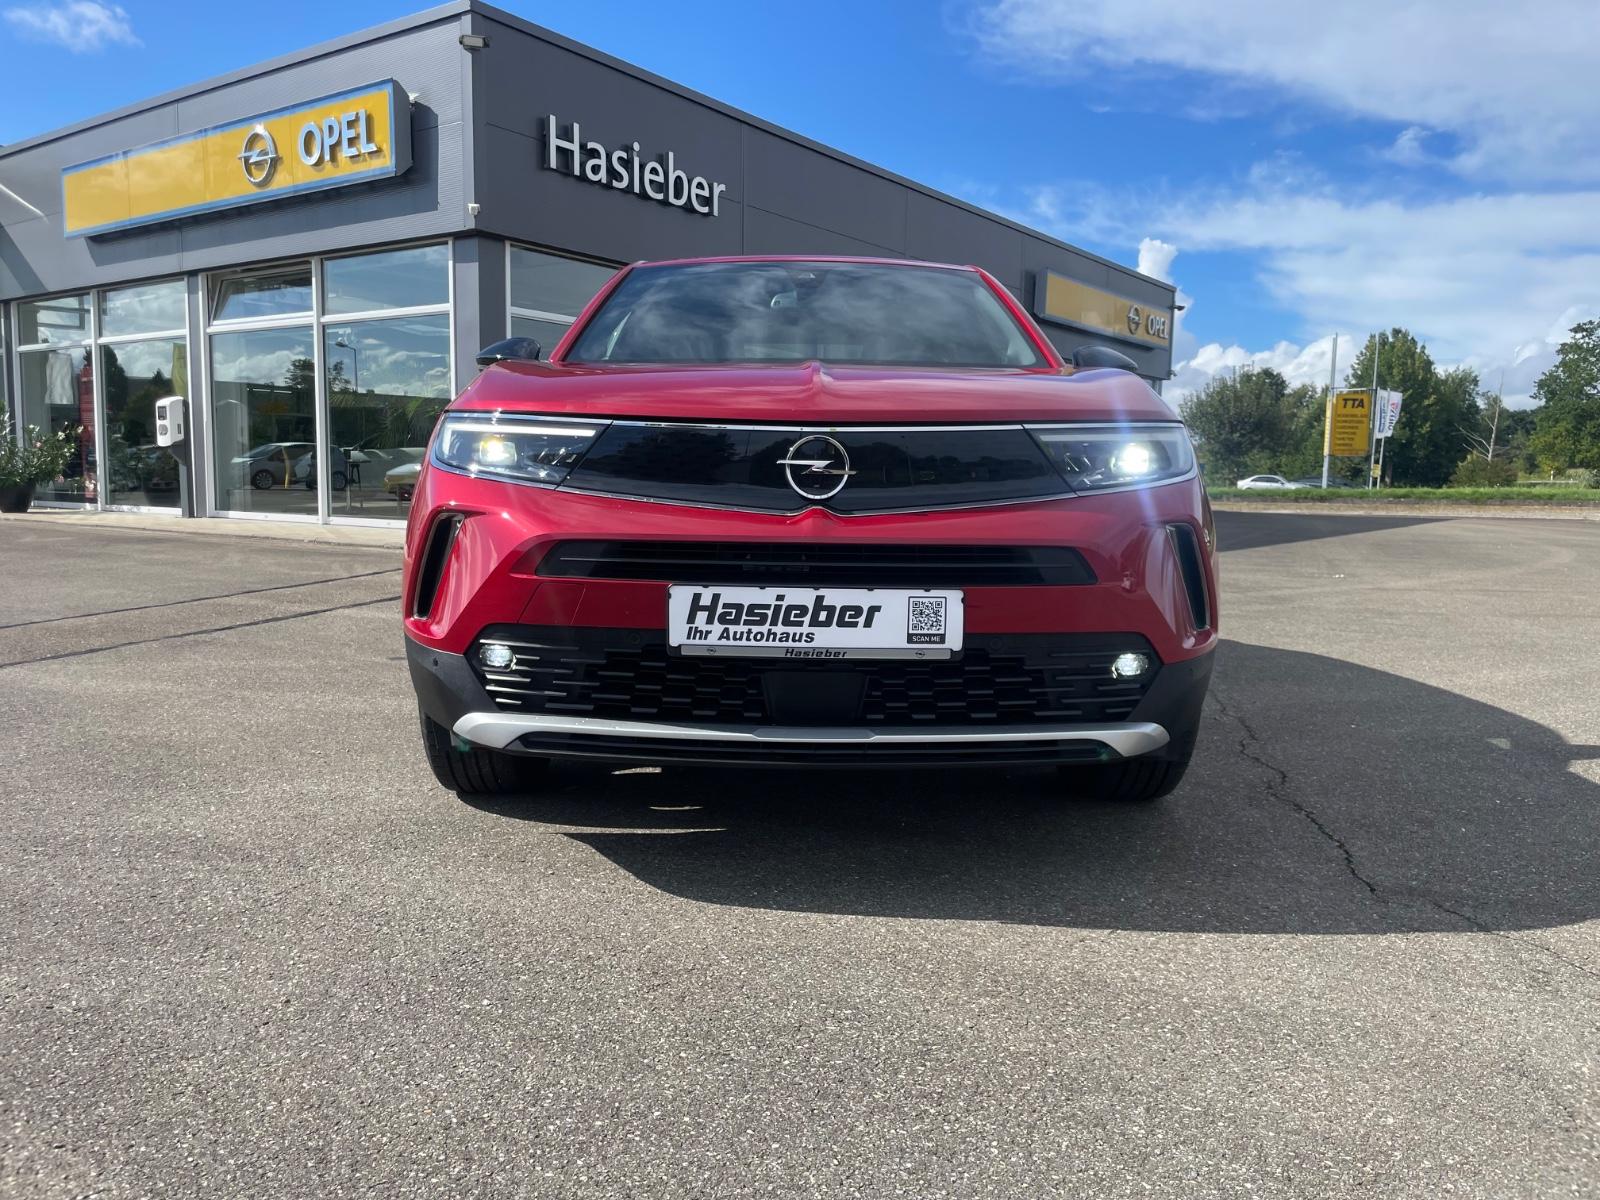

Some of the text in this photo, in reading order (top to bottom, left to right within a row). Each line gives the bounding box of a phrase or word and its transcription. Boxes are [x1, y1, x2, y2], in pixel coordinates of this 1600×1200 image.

[298, 108, 378, 167] OPEL
[545, 114, 726, 217] Hasieber
[1147, 315, 1169, 339] OPEL
[1342, 398, 1365, 409] TTA
[686, 592, 882, 628] Hasieber
[686, 626, 816, 644] Ihr Autohaus
[784, 648, 848, 659] Hasieber
